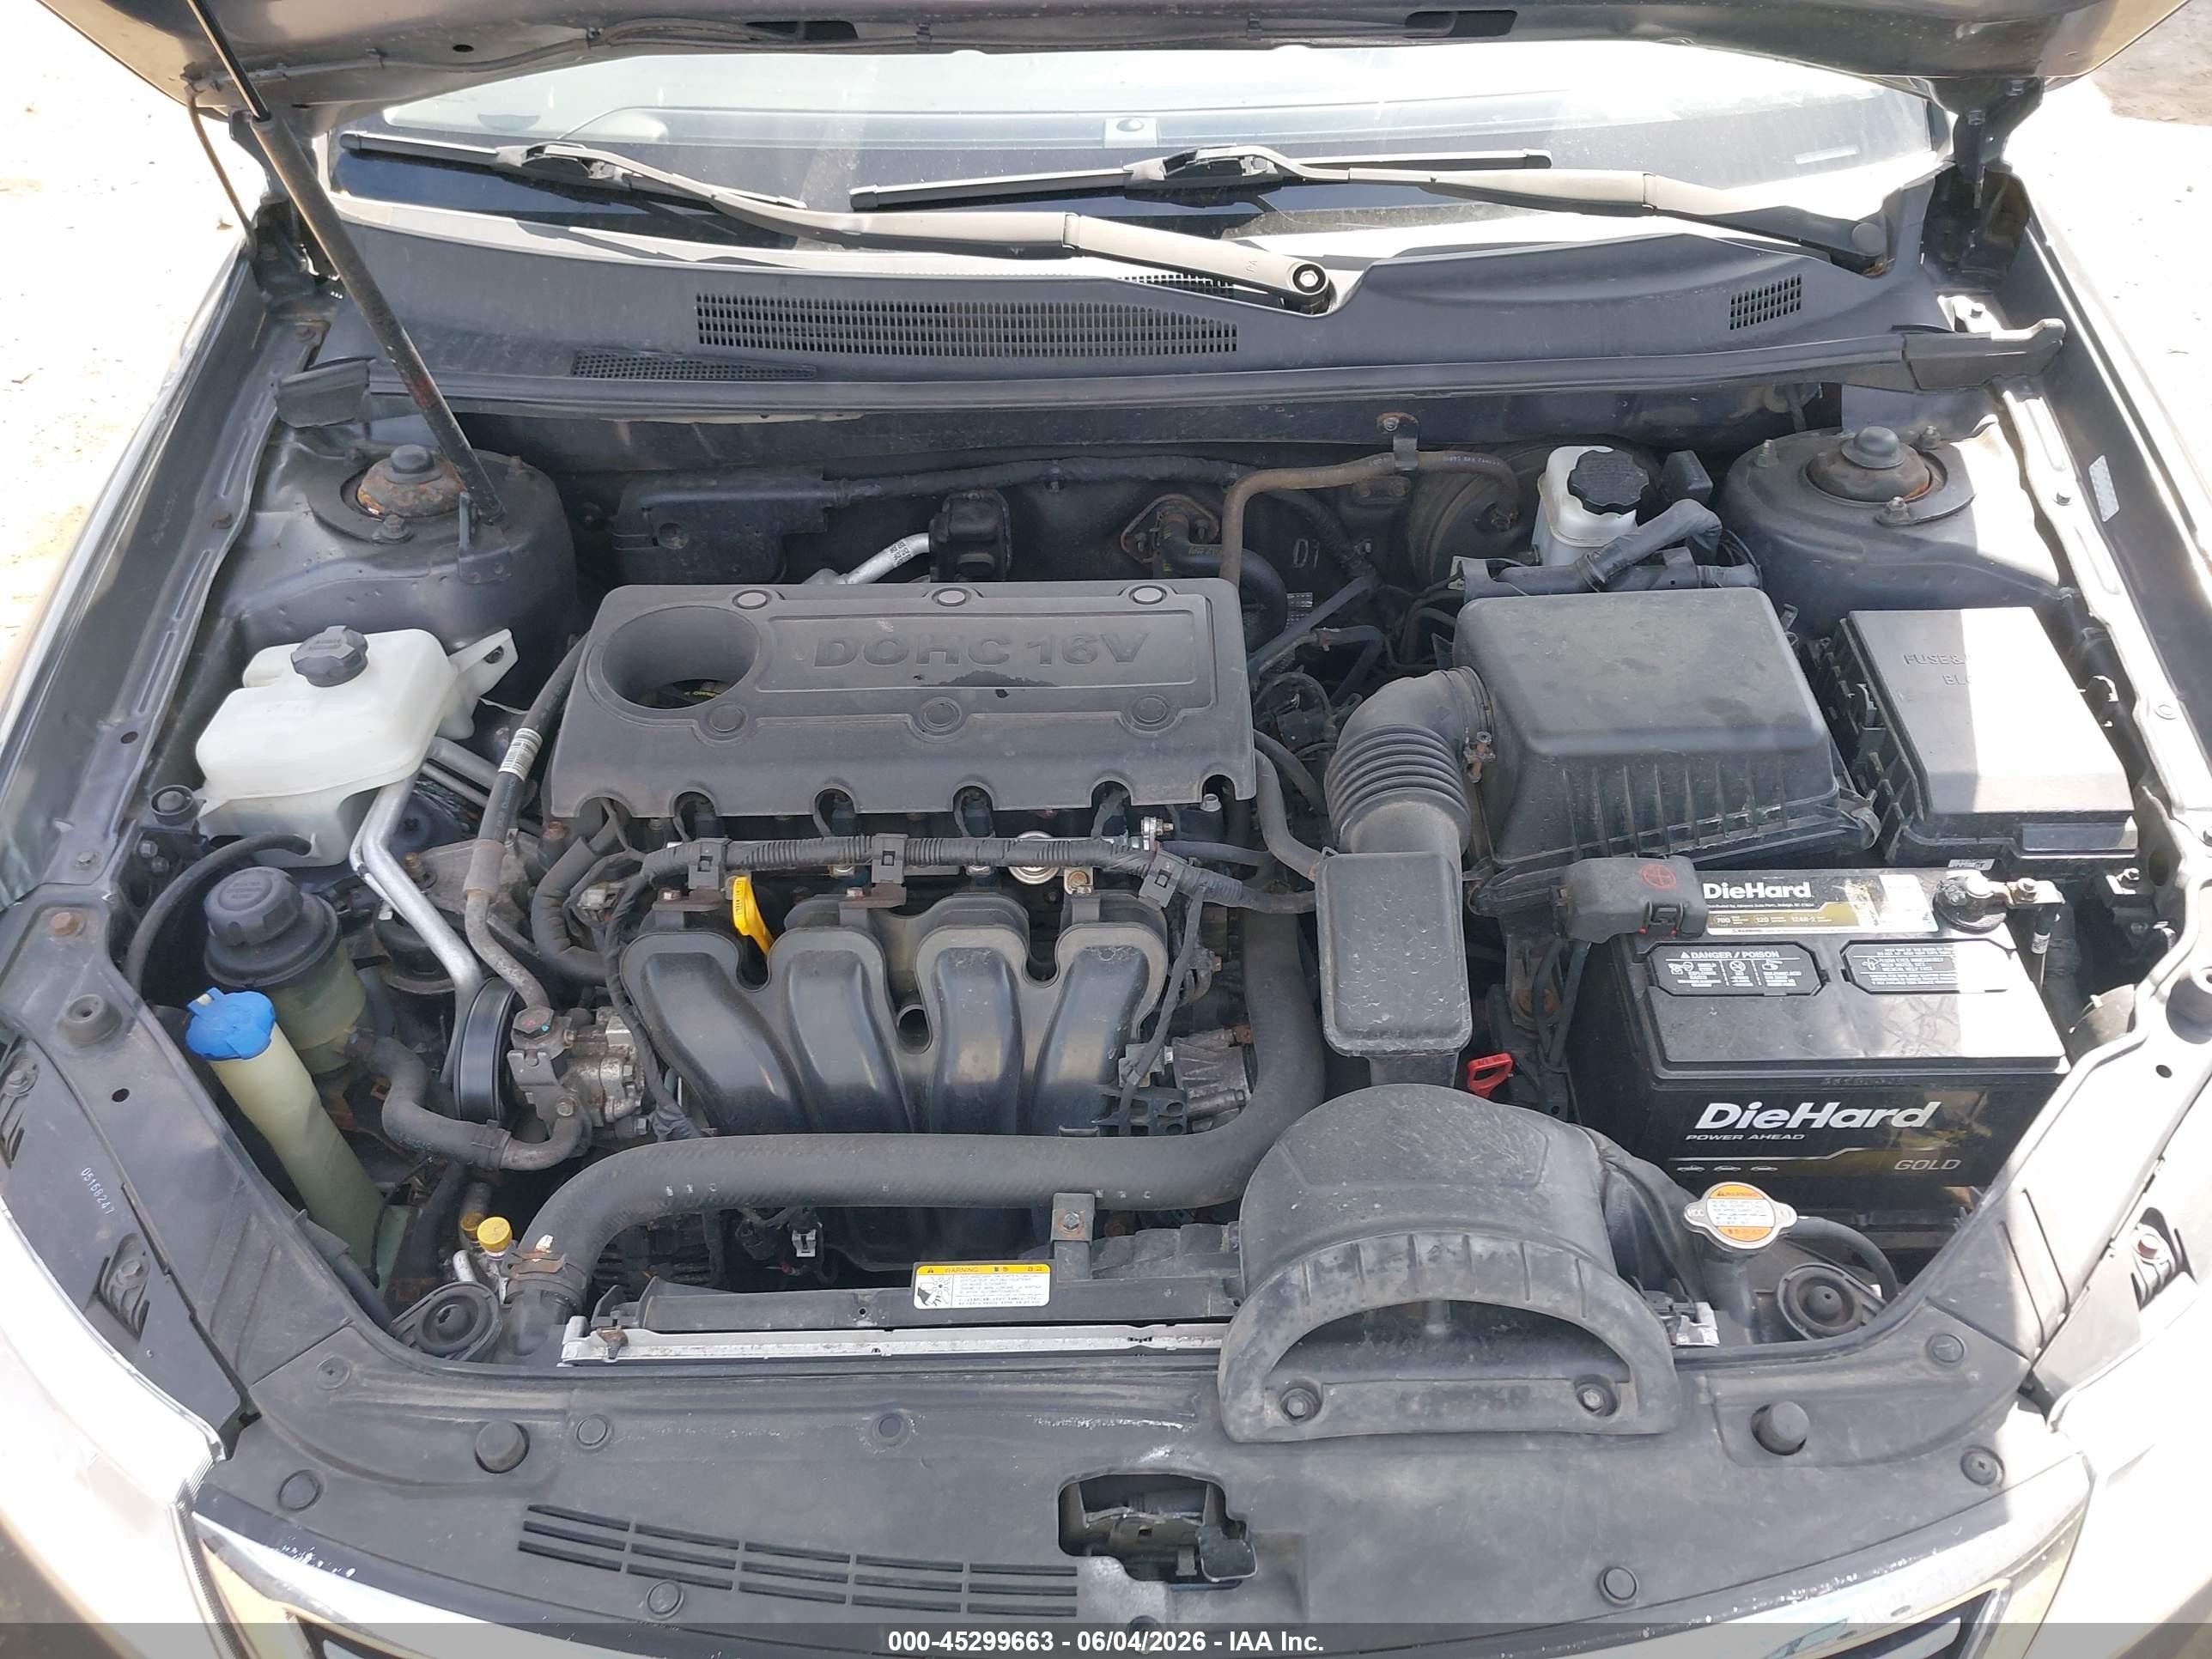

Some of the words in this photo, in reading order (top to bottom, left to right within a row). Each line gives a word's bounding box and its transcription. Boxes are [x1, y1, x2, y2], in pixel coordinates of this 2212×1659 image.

[813, 634, 1011, 667] DOHC
[1028, 632, 1150, 666] 16V
[1703, 882, 1812, 899] DieHard
[1694, 1101, 1942, 1129] DieHard
[1893, 1159, 1961, 1170] GOLD
[81, 1168, 115, 1215] 05168247
